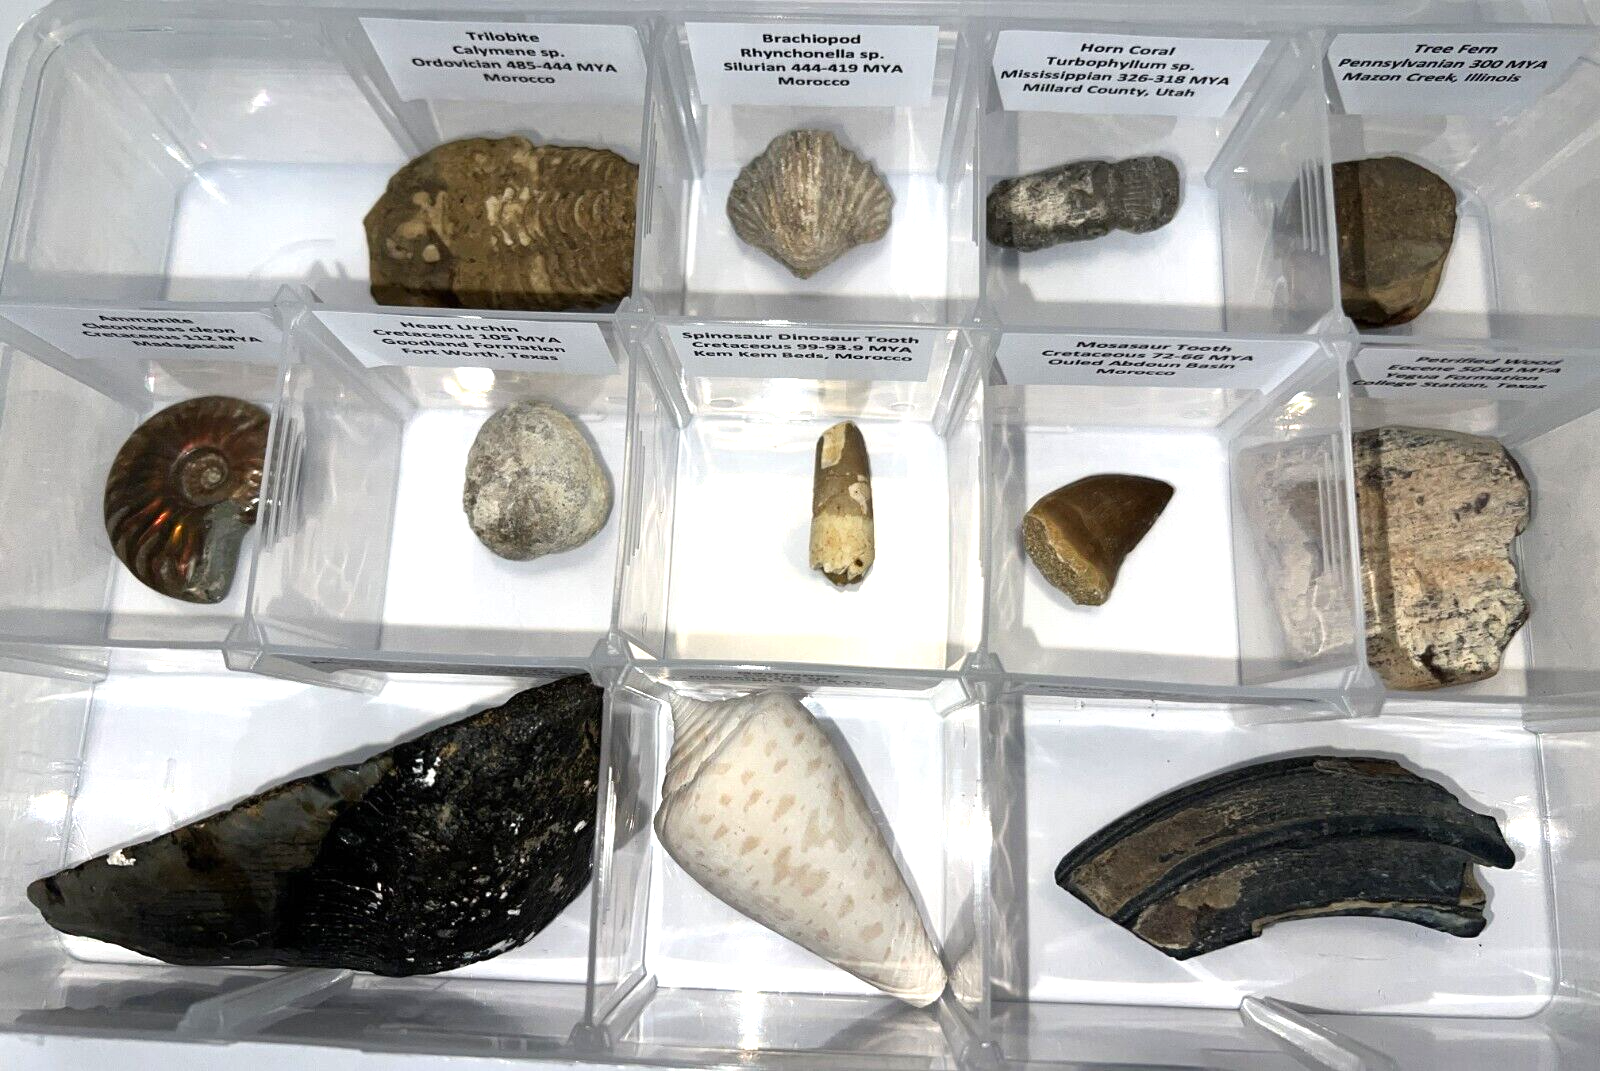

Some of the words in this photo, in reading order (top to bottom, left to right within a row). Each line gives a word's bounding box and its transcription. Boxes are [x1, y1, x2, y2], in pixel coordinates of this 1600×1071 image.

[466, 32, 540, 42] Trilobite
[763, 34, 861, 46] Brachiopod
[453, 46, 536, 57] Calymene
[541, 50, 564, 58] sp.
[741, 49, 854, 59] Rhynchonella
[860, 52, 884, 60] sp.
[1080, 43, 1123, 54] Horn
[1129, 46, 1176, 56] Coral
[1414, 44, 1453, 53] Tree
[1458, 45, 1498, 54] Fern
[412, 58, 501, 69] Ordovician
[506, 61, 572, 71] 485-444
[577, 64, 617, 72] MYA
[724, 63, 786, 72] Silurian
[792, 64, 857, 73] 444-419
[863, 65, 903, 73] MYA
[1047, 57, 1166, 70] Turbophyllum
[1171, 62, 1194, 71] sp.
[1338, 59, 1465, 69] Pennsylvanian
[1469, 60, 1500, 68] 300
[1505, 60, 1547, 69] MYA
[484, 73, 555, 84] Morocco
[778, 77, 850, 86] Morocco
[1001, 70, 1112, 82] Mississippian
[1117, 74, 1185, 84] 326-318
[1189, 76, 1229, 85] MYA
[1342, 73, 1401, 81] Mazon
[1407, 73, 1457, 83] Creek,
[1464, 73, 1521, 82] Illinois
[1023, 83, 1082, 93] Millard
[1087, 86, 1148, 97] County,
[1156, 88, 1195, 97] Utah
[99, 315, 194, 324] Ammonite
[400, 322, 453, 330] Heart
[82, 331, 180, 340] Cretaceous
[219, 335, 262, 343] MYA
[373, 329, 474, 340] Cretaceous
[683, 332, 772, 341] Spinosaur
[778, 334, 859, 342] Dinosaur
[865, 336, 919, 344] Tooth
[132, 341, 235, 350] Madagascar
[382, 338, 468, 348] Goodland
[474, 342, 565, 352] Formation
[692, 342, 791, 350] Cretaceous
[869, 345, 912, 353] MYA
[1076, 341, 1171, 350] Mosasaur
[1176, 344, 1232, 352] Tooth
[506, 352, 558, 361] Texas
[1042, 350, 1145, 359] Cretaceous
[1108, 360, 1181, 368] Abdoun
[1352, 380, 1417, 388] College
